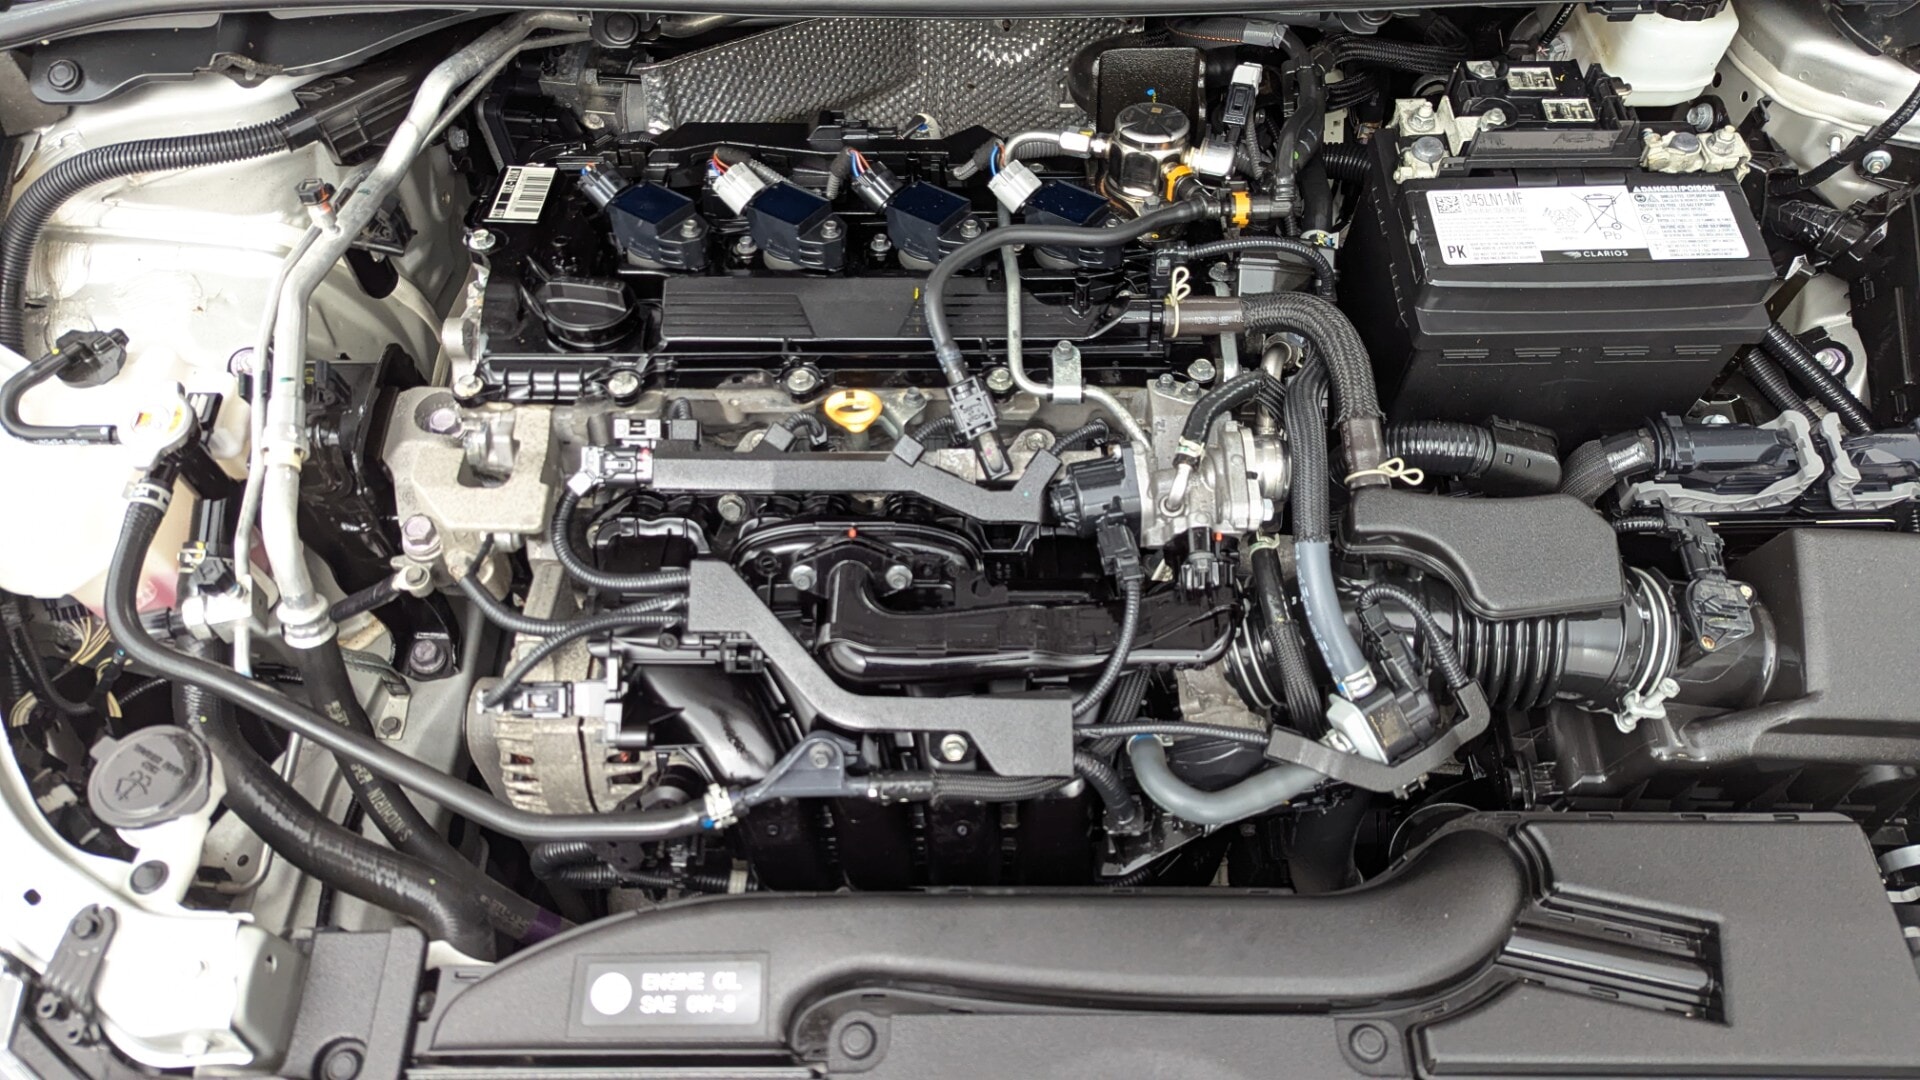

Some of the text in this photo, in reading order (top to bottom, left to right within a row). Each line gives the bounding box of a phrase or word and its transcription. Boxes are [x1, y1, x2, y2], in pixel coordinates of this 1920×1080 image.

[1640, 184, 1717, 193] DANGER/POISON
[1463, 190, 1523, 207] 345LN1-MF
[1603, 230, 1622, 240] Pb
[1447, 244, 1467, 259] PK
[1583, 249, 1629, 258] CLARIOS
[641, 970, 743, 992] ENGINE OIL
[639, 994, 677, 1014] SAE
